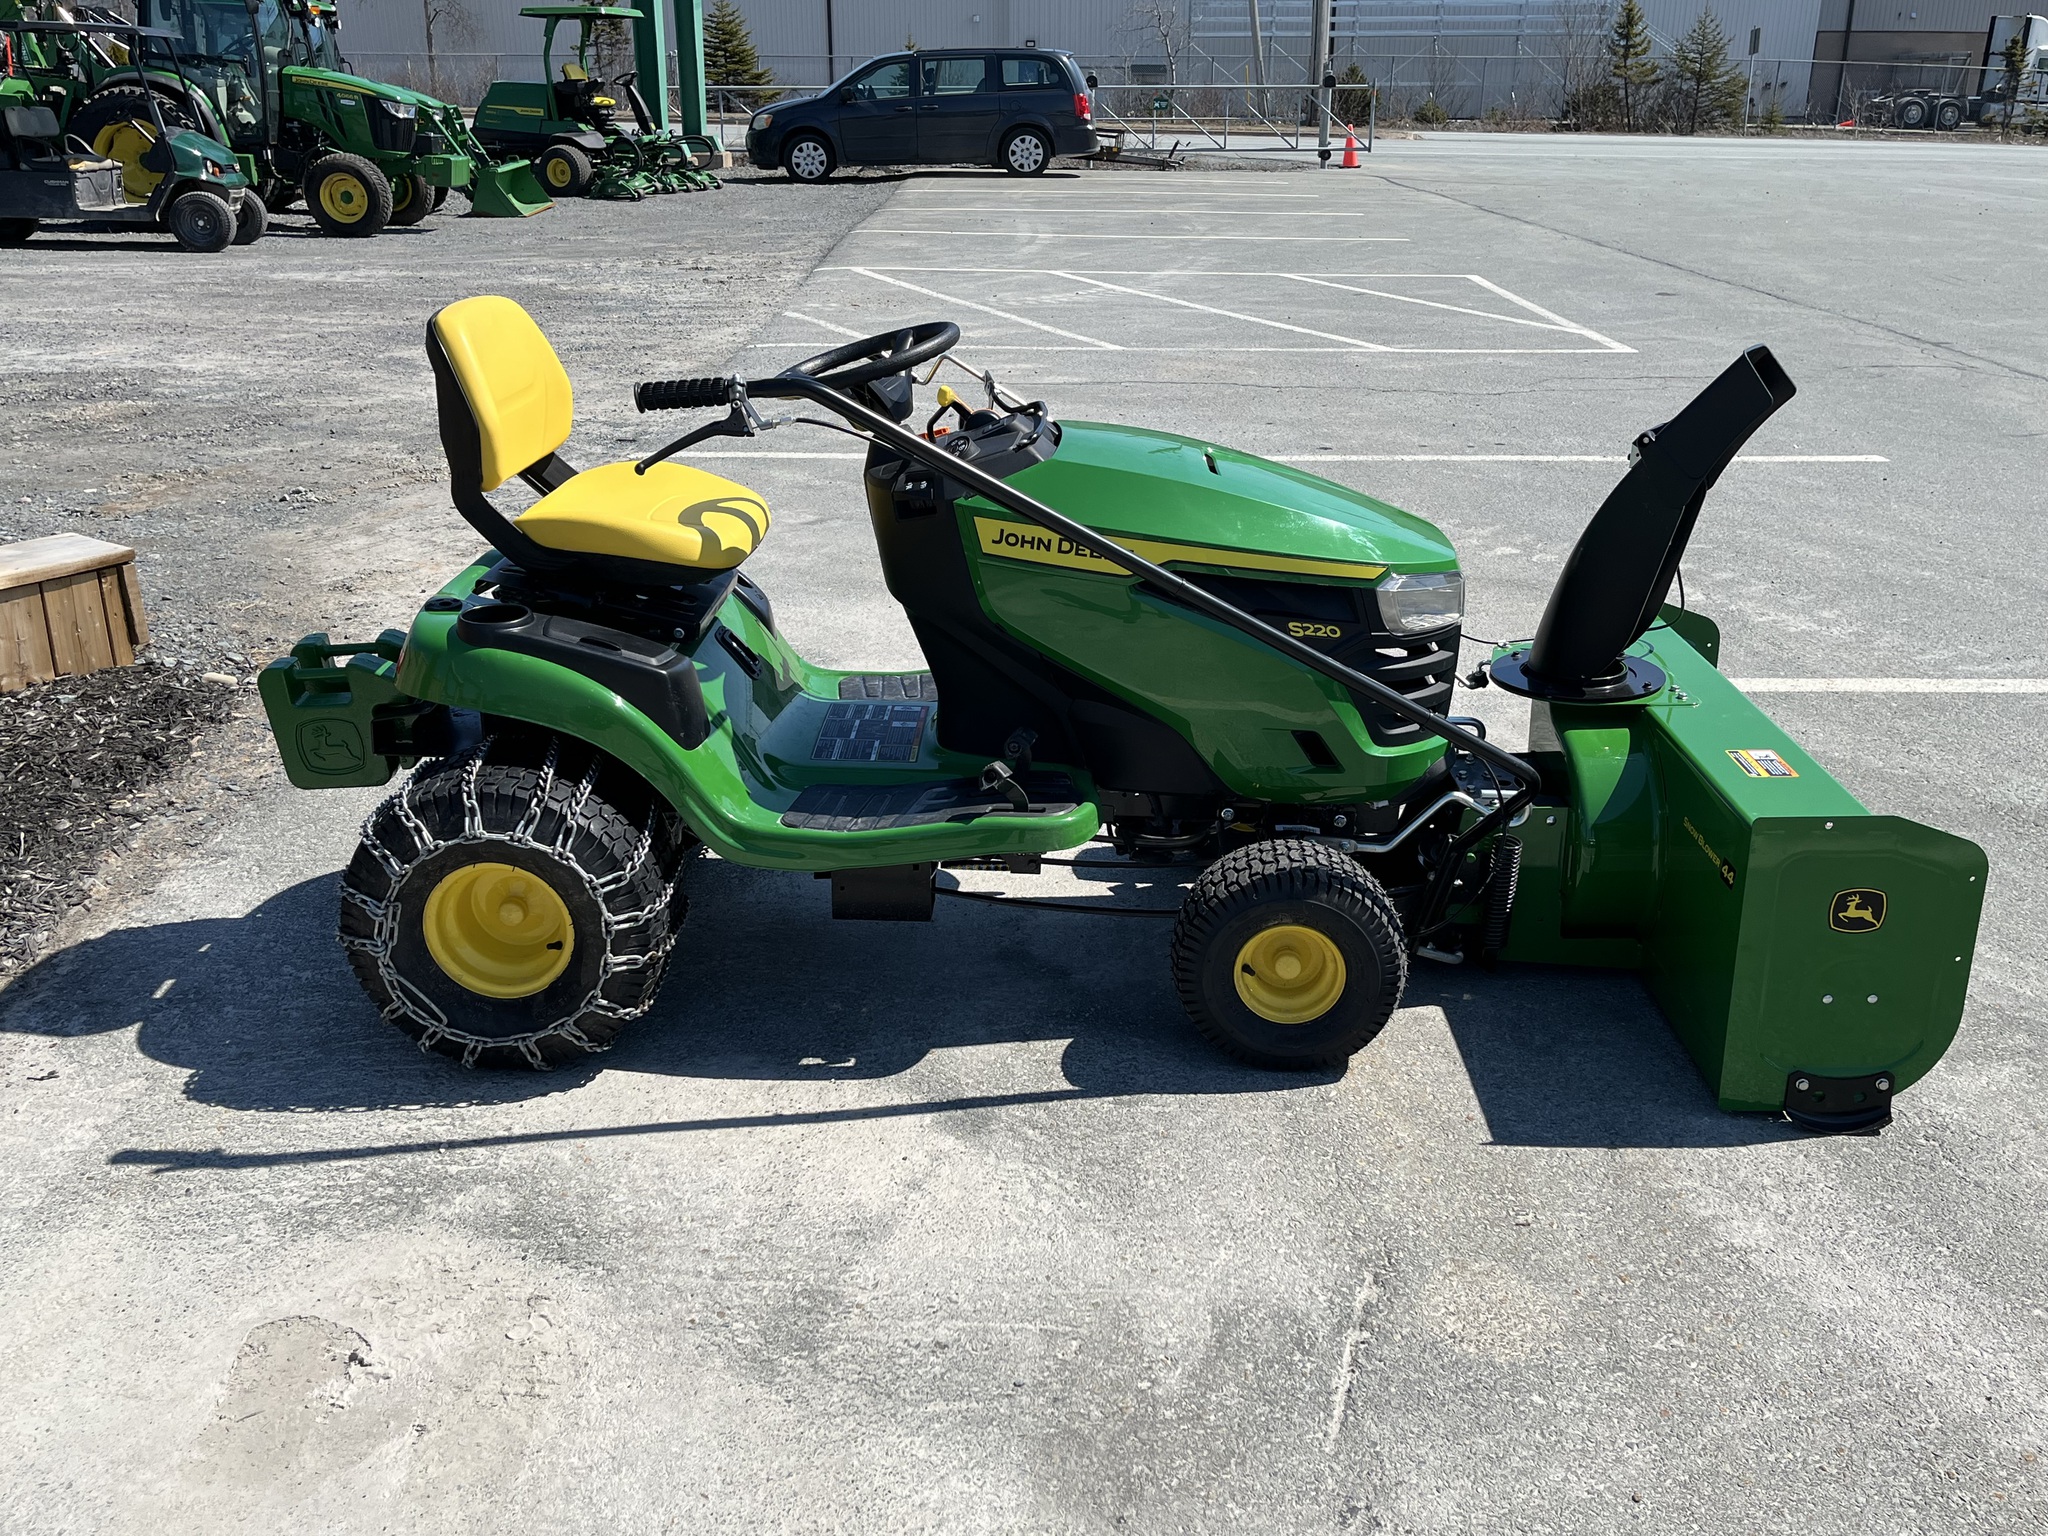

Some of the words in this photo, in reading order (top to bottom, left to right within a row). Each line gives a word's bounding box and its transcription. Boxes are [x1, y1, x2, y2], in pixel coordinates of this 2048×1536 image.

[991, 528, 1052, 553] JOHN
[1288, 621, 1341, 638] S220
[1683, 816, 1699, 840] SNOW
[1698, 834, 1721, 868] BLOWER
[1721, 865, 1735, 885] 44
